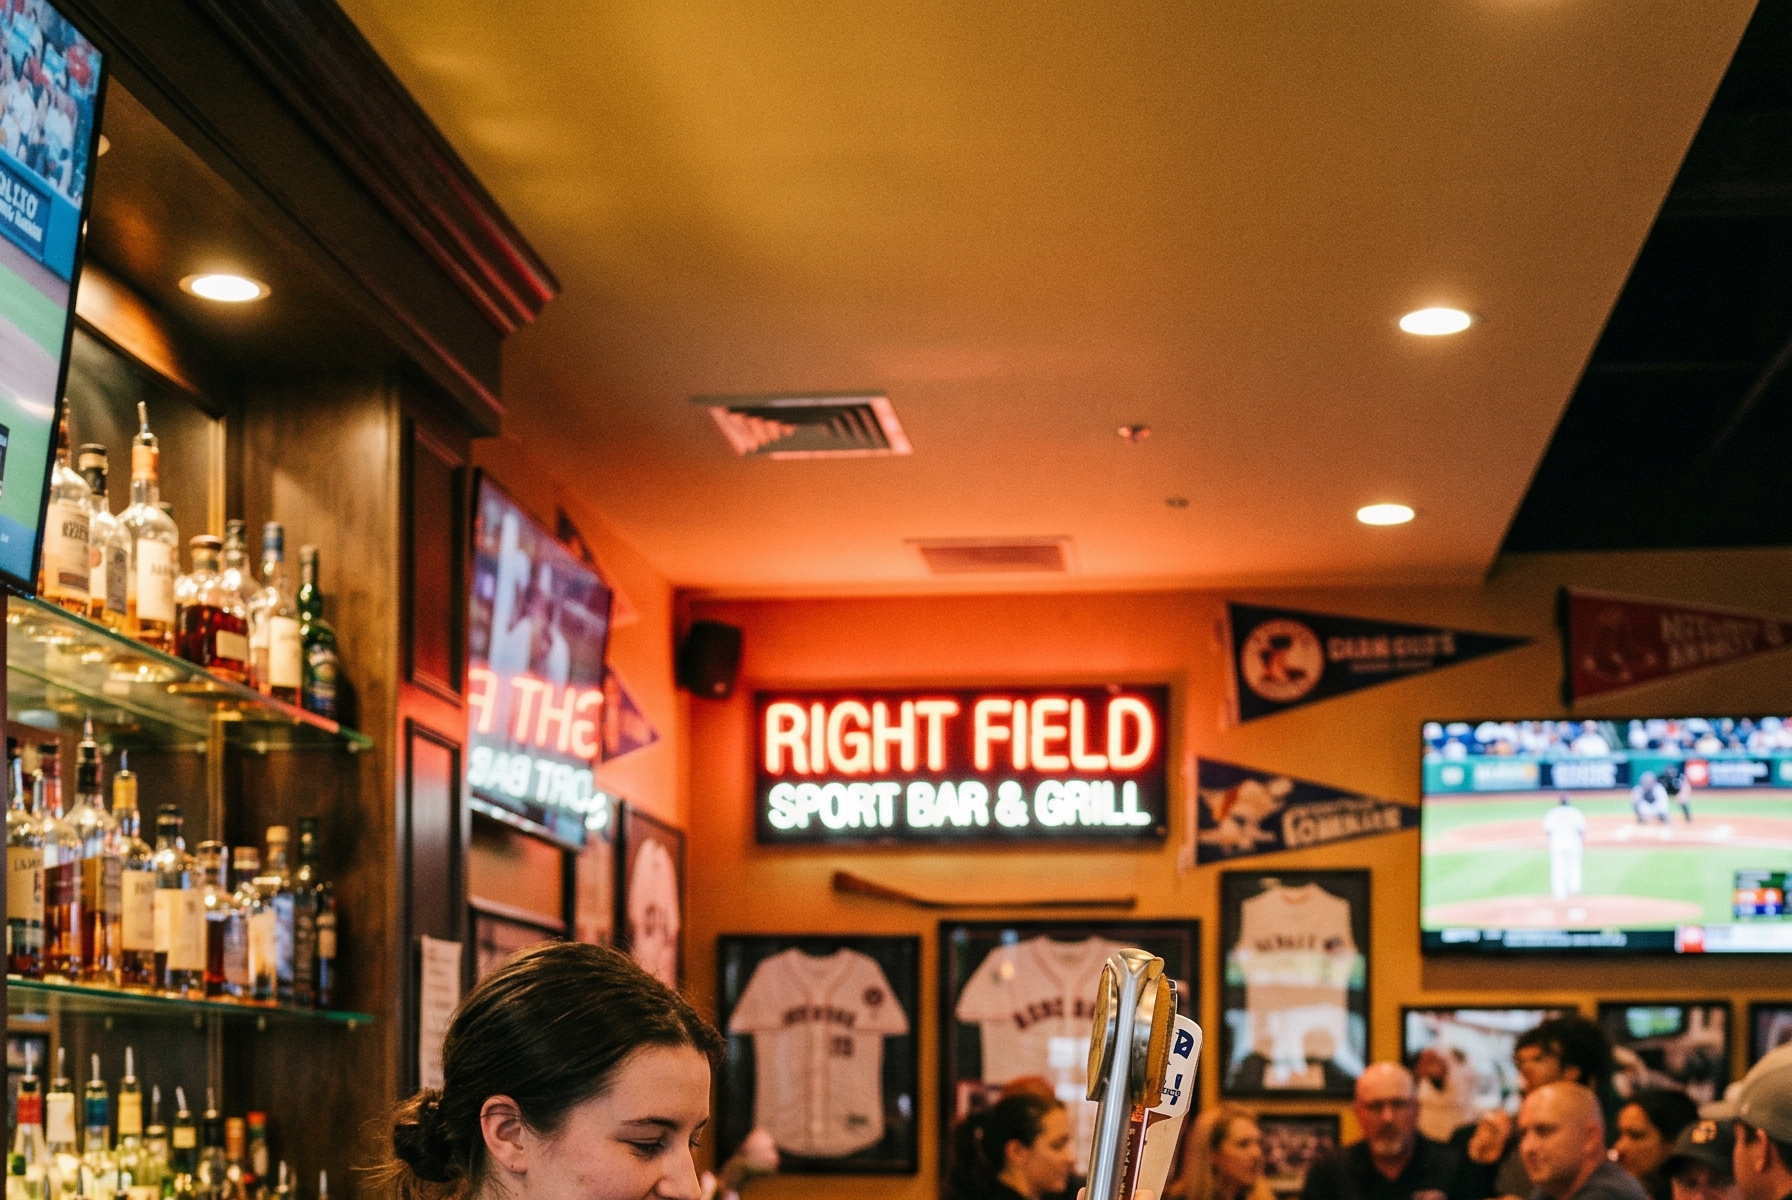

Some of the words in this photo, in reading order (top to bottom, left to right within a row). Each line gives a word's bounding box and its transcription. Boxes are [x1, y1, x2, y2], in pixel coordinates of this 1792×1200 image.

[765, 700, 959, 774] RIGHT
[974, 697, 1155, 772] FIELD
[768, 781, 902, 830] SPORT
[906, 780, 990, 828] BAR
[995, 780, 1030, 827] &
[1034, 780, 1152, 827] GRILL
